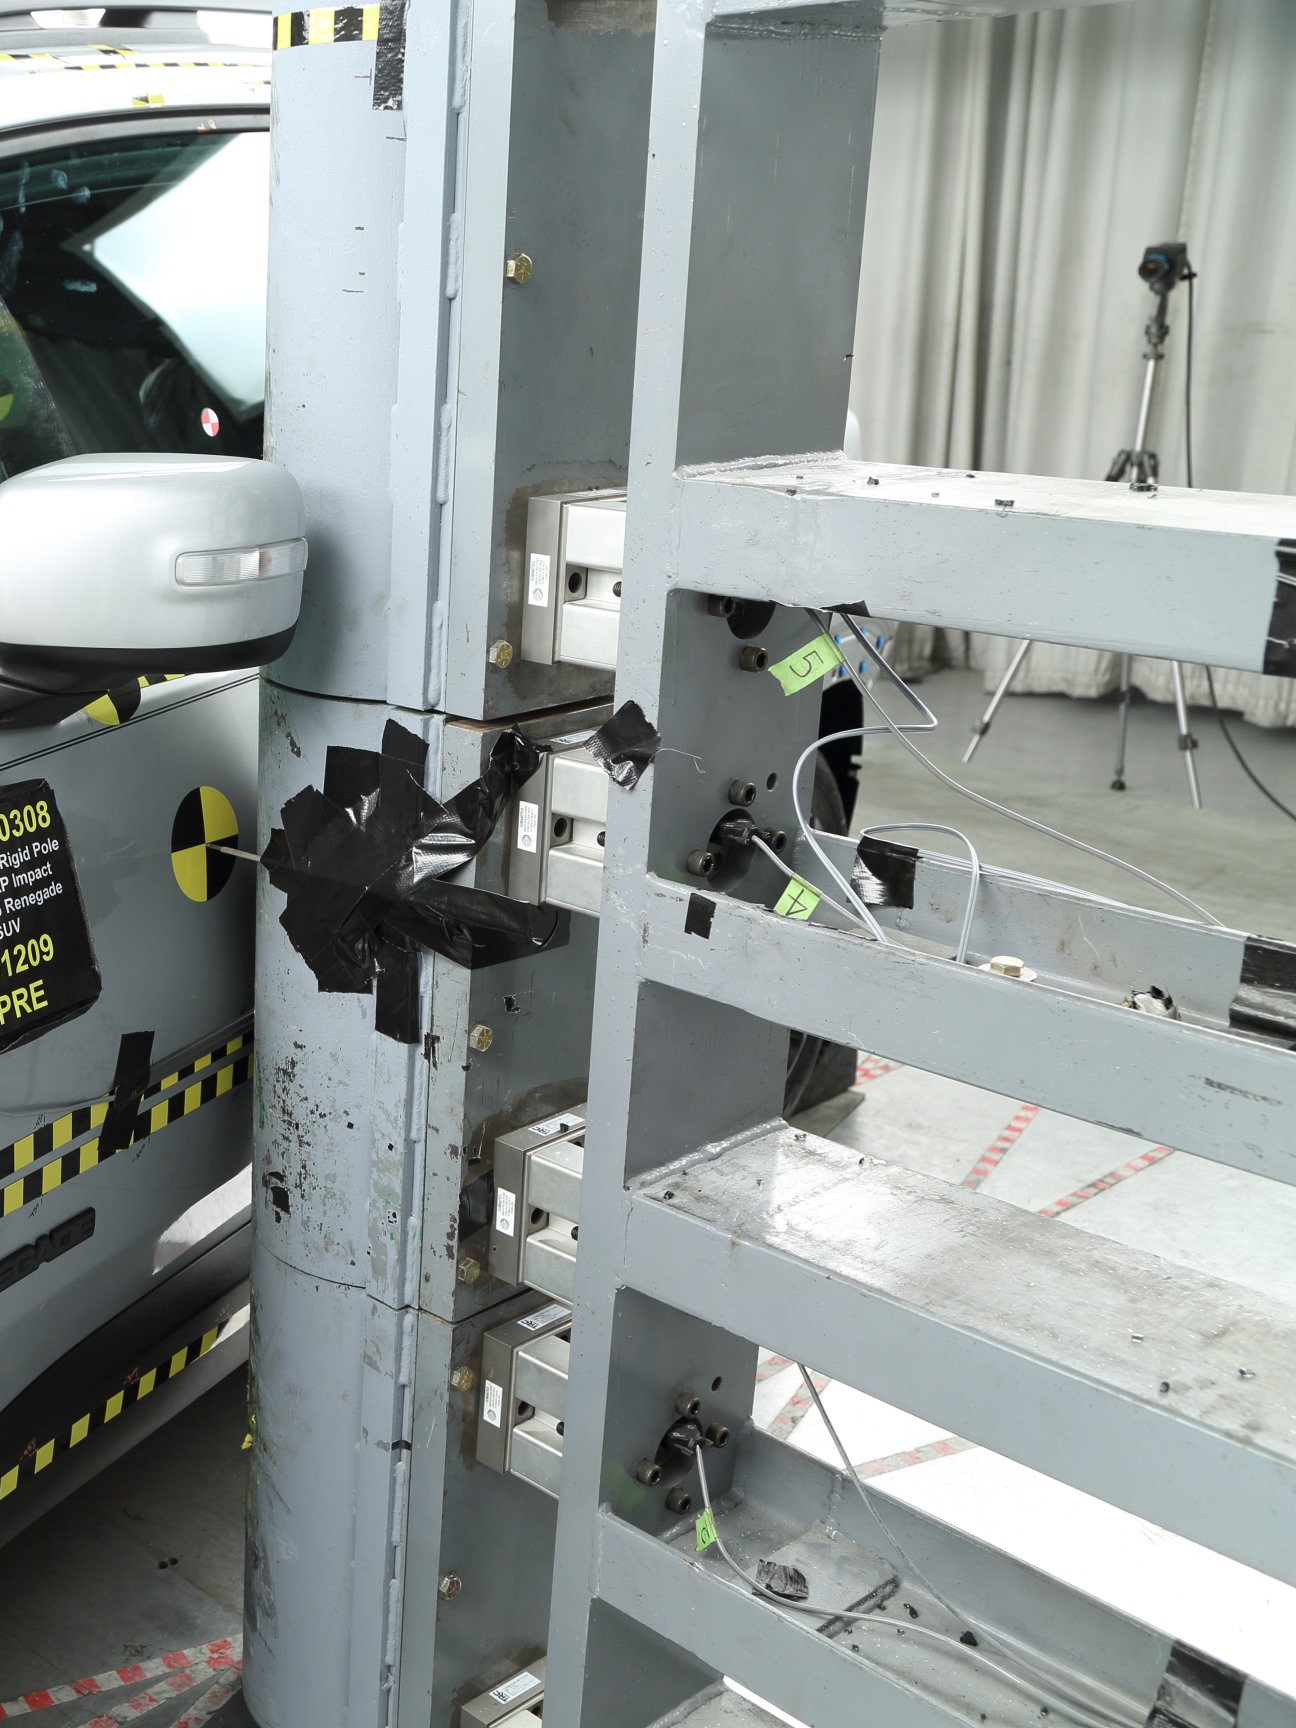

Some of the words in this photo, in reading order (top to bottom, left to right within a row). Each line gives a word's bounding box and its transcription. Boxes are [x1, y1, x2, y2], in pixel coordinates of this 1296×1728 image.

[788, 648, 824, 679] 5
[32, 837, 60, 860] Pole
[13, 862, 53, 890] Impact
[5, 881, 64, 914] Renegade
[784, 888, 809, 916] 4
